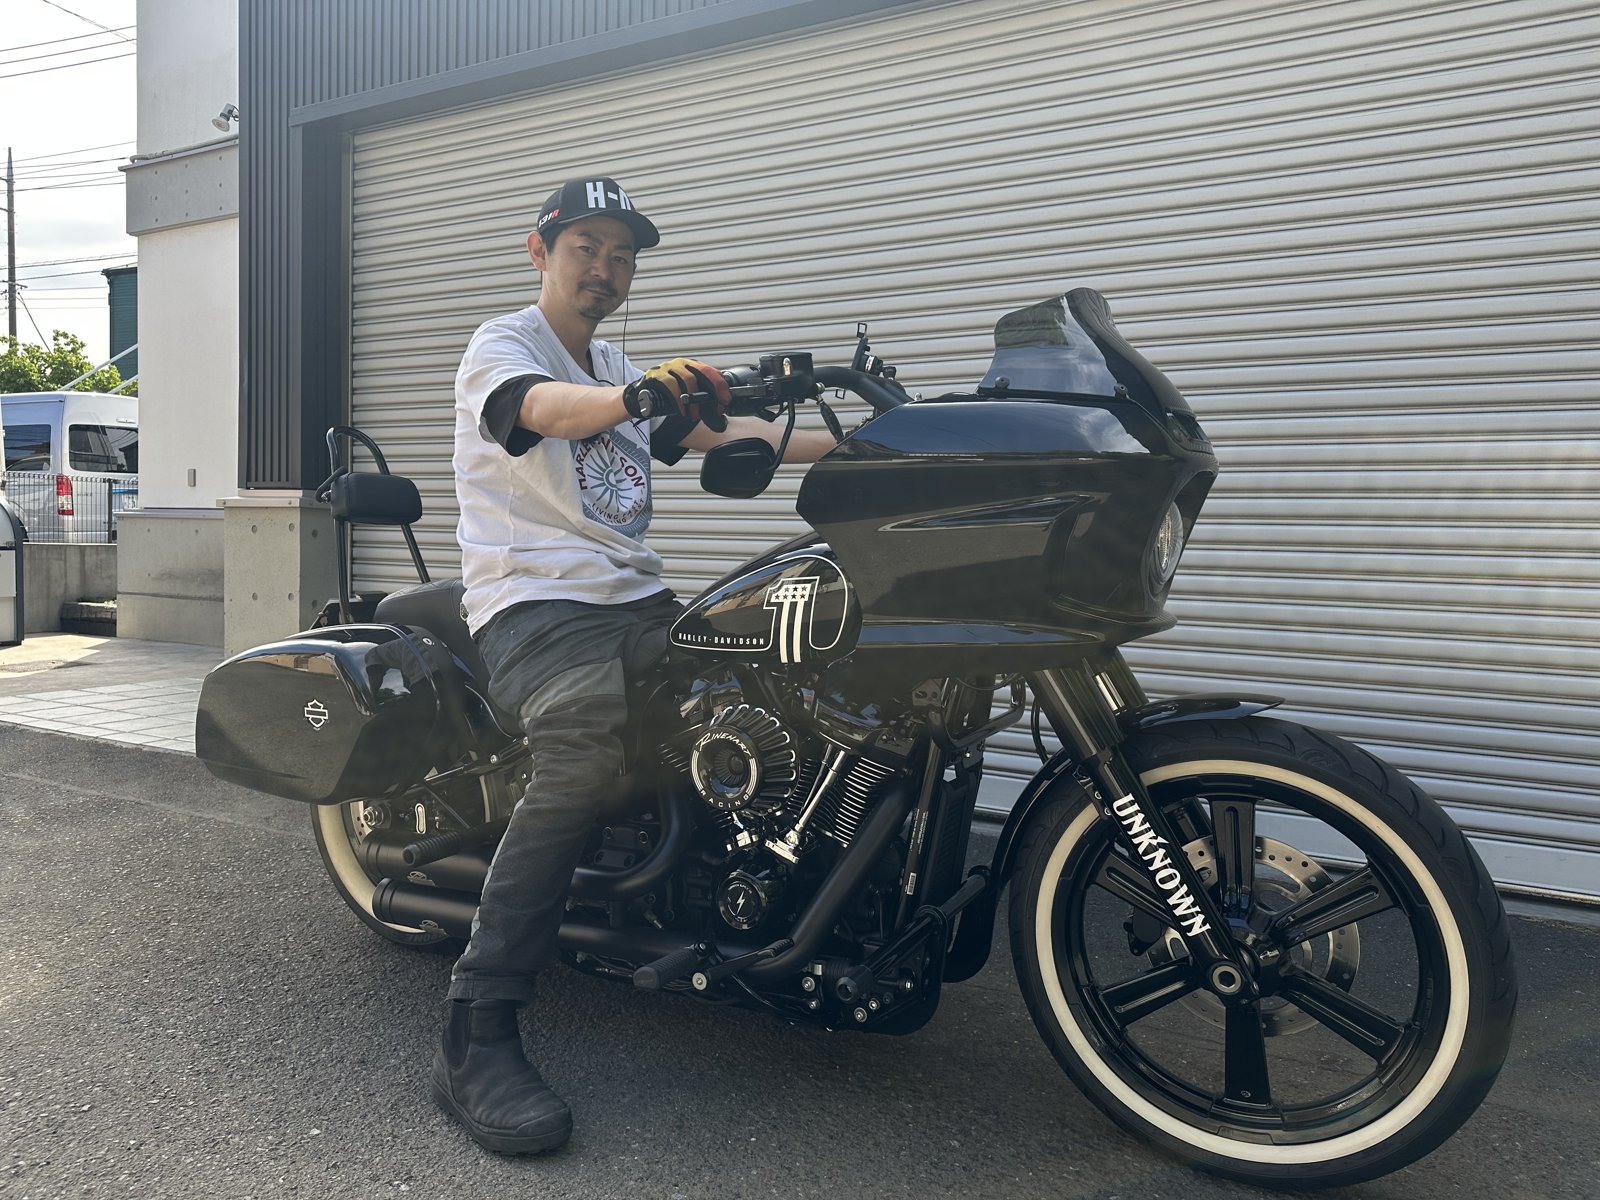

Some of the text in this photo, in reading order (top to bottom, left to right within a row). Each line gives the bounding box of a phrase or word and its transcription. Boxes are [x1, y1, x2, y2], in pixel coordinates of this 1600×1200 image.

[678, 632, 765, 645] HARLEY-DAVIDSON
[695, 731, 752, 757] RINEHART
[700, 789, 749, 809] RACING
[1112, 793, 1211, 937] UNKNOWN
